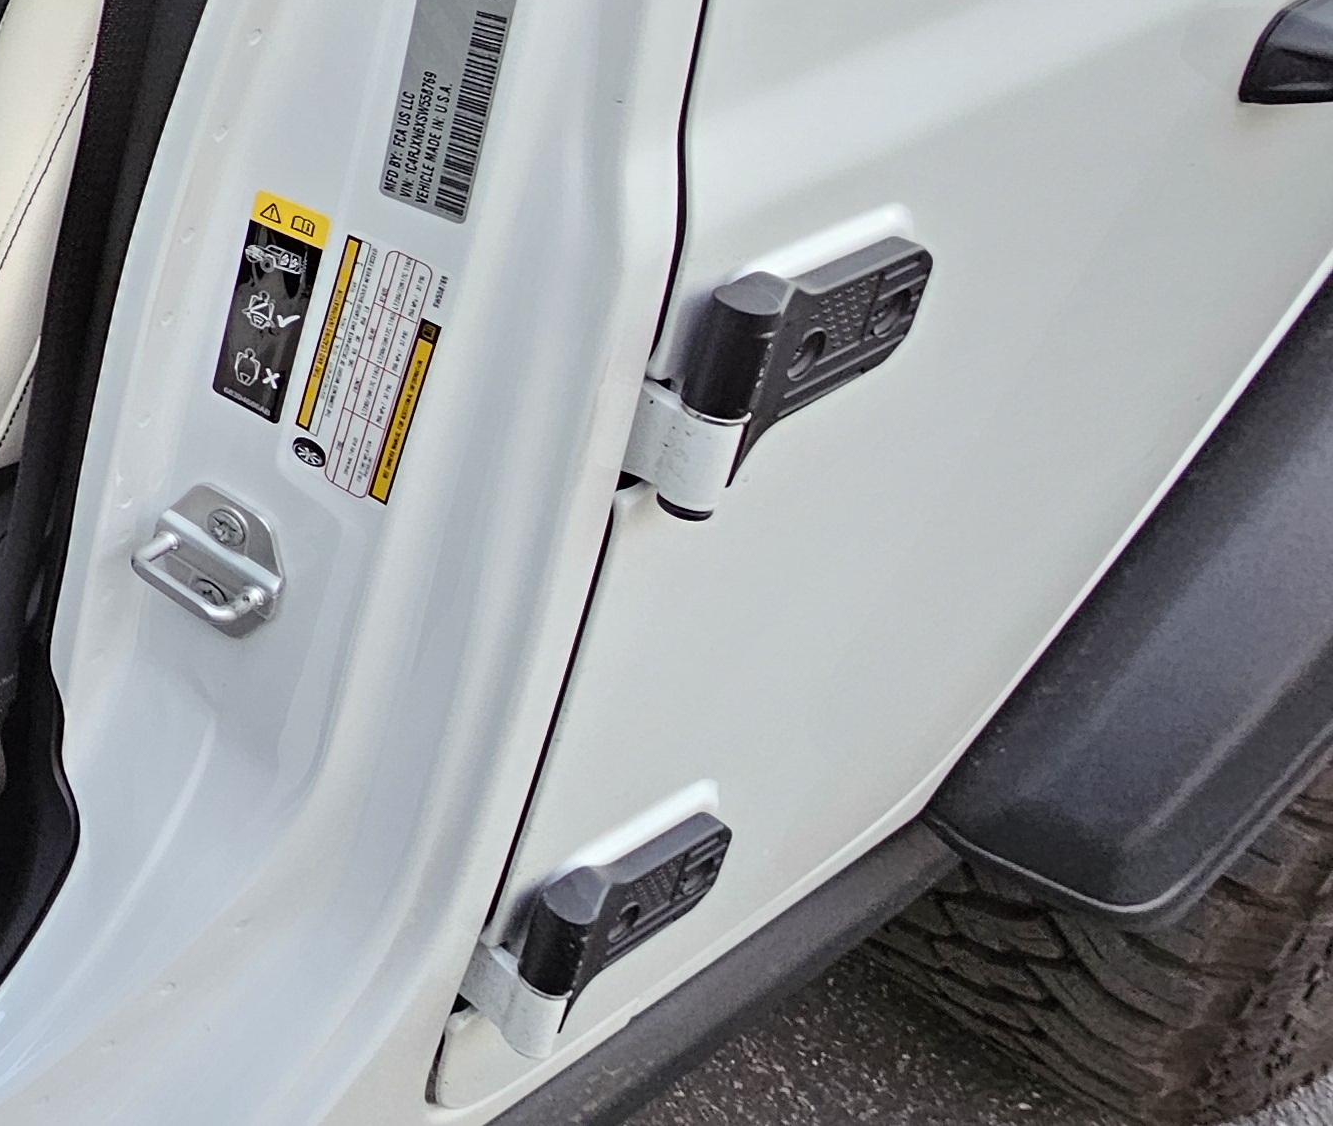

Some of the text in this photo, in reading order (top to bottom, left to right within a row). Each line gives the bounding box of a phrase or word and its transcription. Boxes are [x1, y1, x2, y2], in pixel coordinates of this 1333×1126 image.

[383, 91, 415, 193] MFD BY: FCA US LLC
[399, 71, 437, 198] VIN: 1C4RJXN6XSW558769
[431, 116, 445, 131] IN:
[424, 132, 442, 163] MADE
[415, 163, 435, 204] VEHICLE
